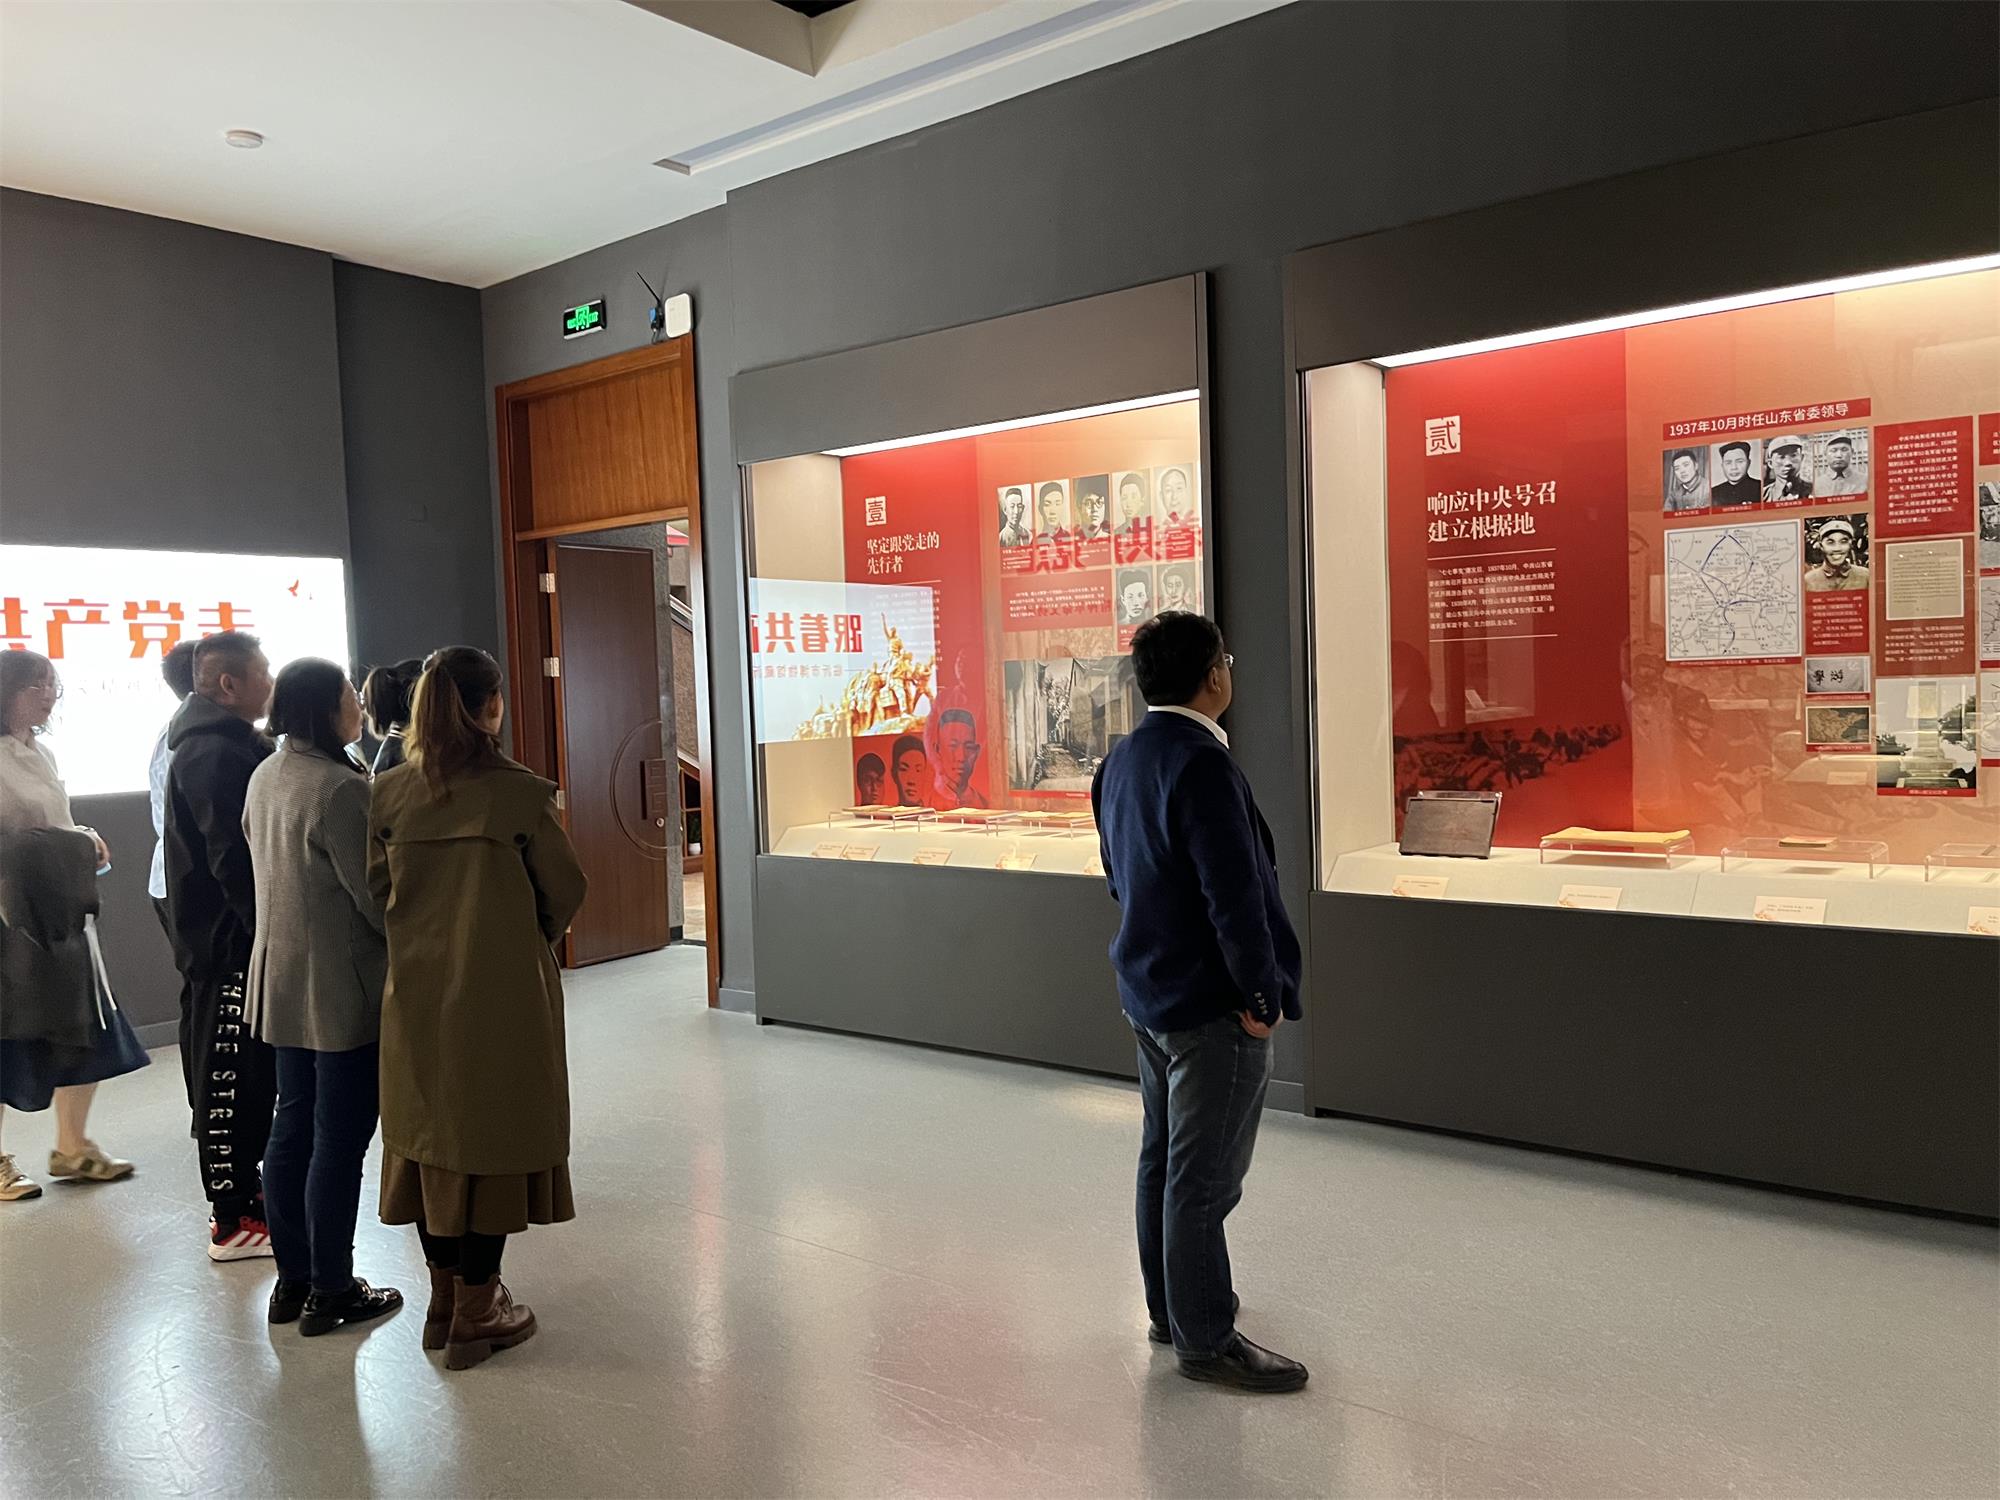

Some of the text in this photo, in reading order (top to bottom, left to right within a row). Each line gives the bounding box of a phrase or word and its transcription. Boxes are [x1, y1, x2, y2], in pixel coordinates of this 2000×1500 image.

[1670, 402, 1849, 437] 1937年10月时任山东省委领导
[1430, 421, 1456, 452] 贰
[1427, 480, 1557, 516] 响应中央号召
[1427, 511, 1536, 543] 建立根据地
[866, 531, 940, 555] 坚定跟党走的
[867, 554, 904, 575] 先行者
